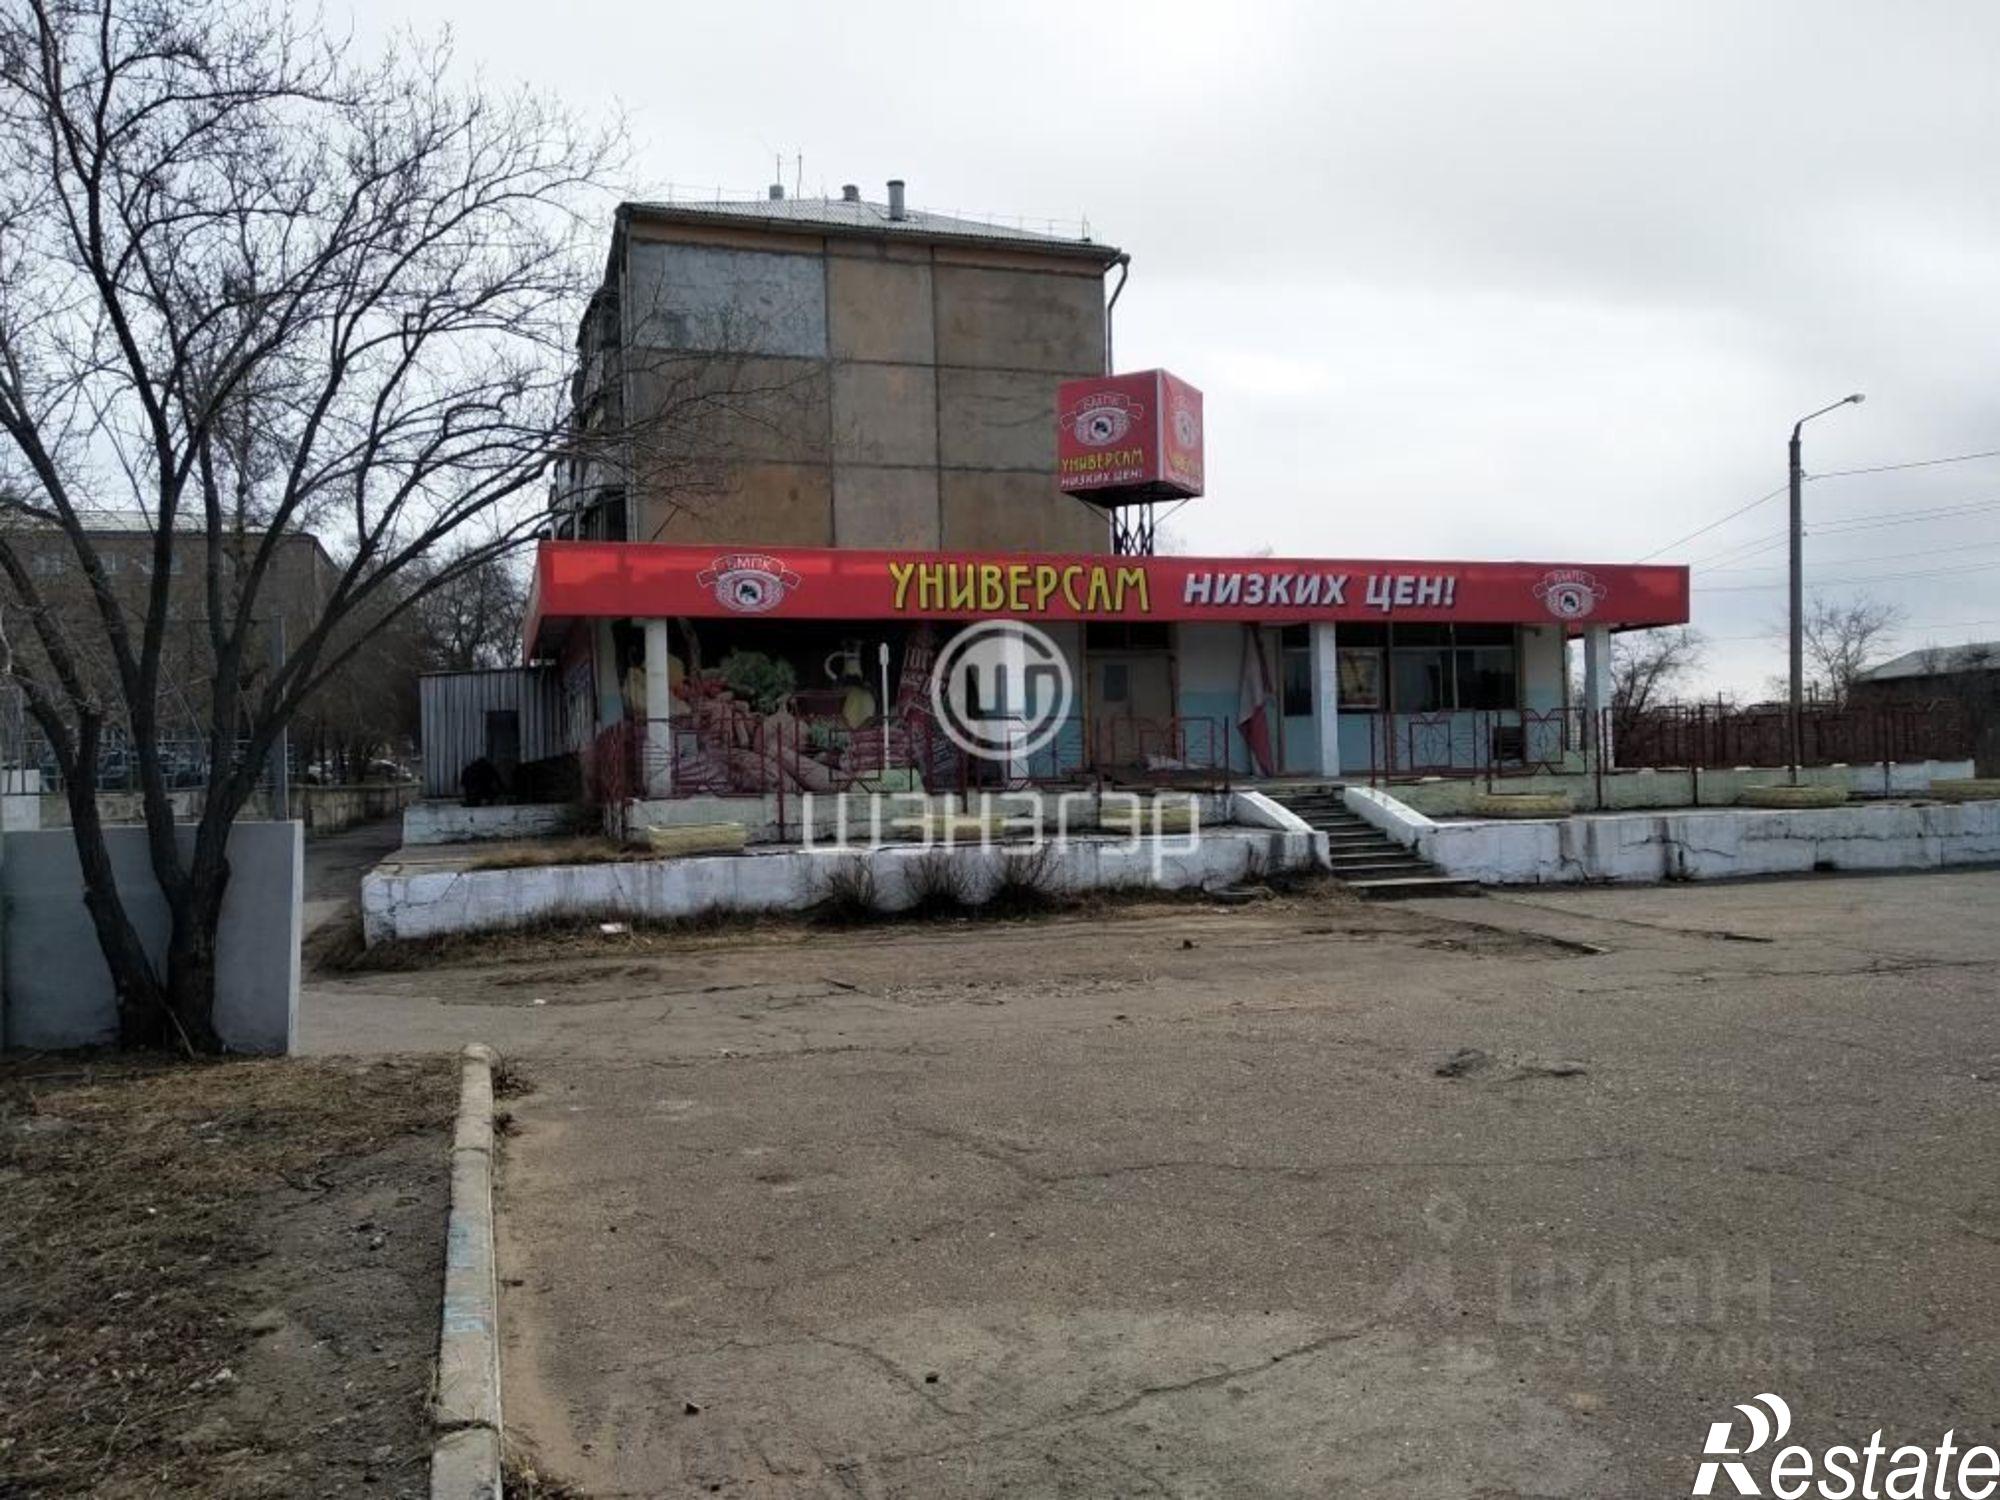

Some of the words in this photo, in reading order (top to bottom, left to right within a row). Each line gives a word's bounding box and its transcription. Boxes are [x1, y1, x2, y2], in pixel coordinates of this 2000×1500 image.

[1061, 447, 1144, 474] УНИВЕРСАМ
[888, 561, 1151, 613] УНИВЕРСАМ
[1183, 572, 1348, 606] НИЗКИХ
[1364, 574, 1457, 613] ЦЕН!
